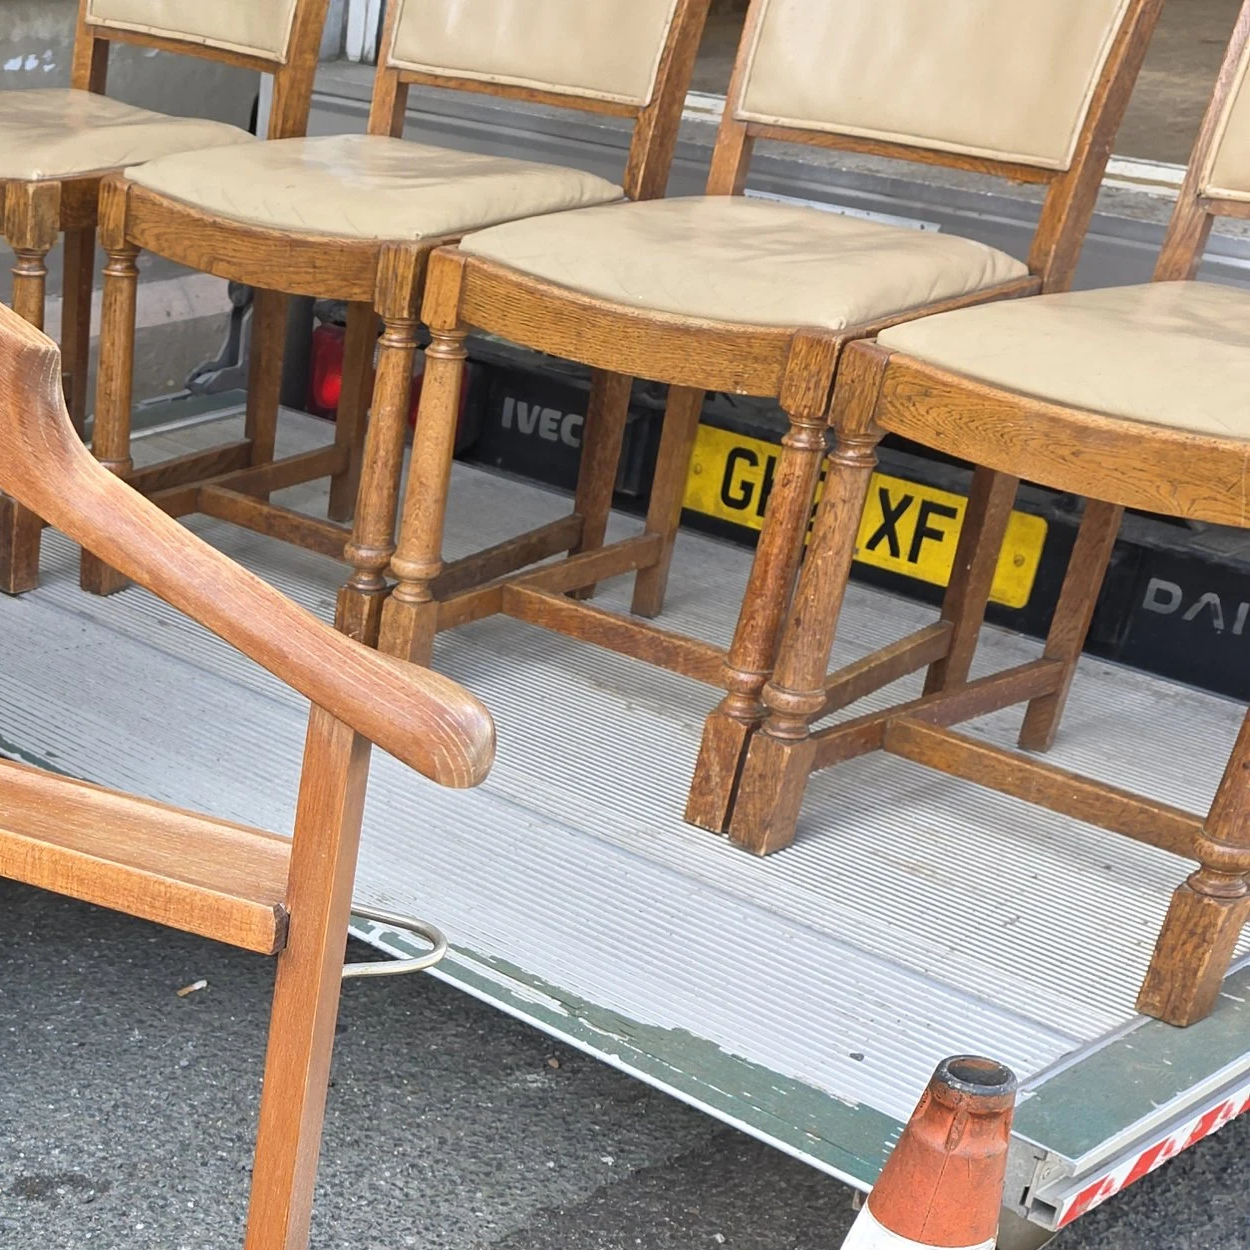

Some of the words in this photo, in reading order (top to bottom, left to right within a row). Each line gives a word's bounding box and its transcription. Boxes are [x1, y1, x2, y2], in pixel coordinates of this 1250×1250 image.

[501, 396, 585, 448] IVEC
[865, 486, 958, 564] XF
[1142, 577, 1250, 635] DAI
